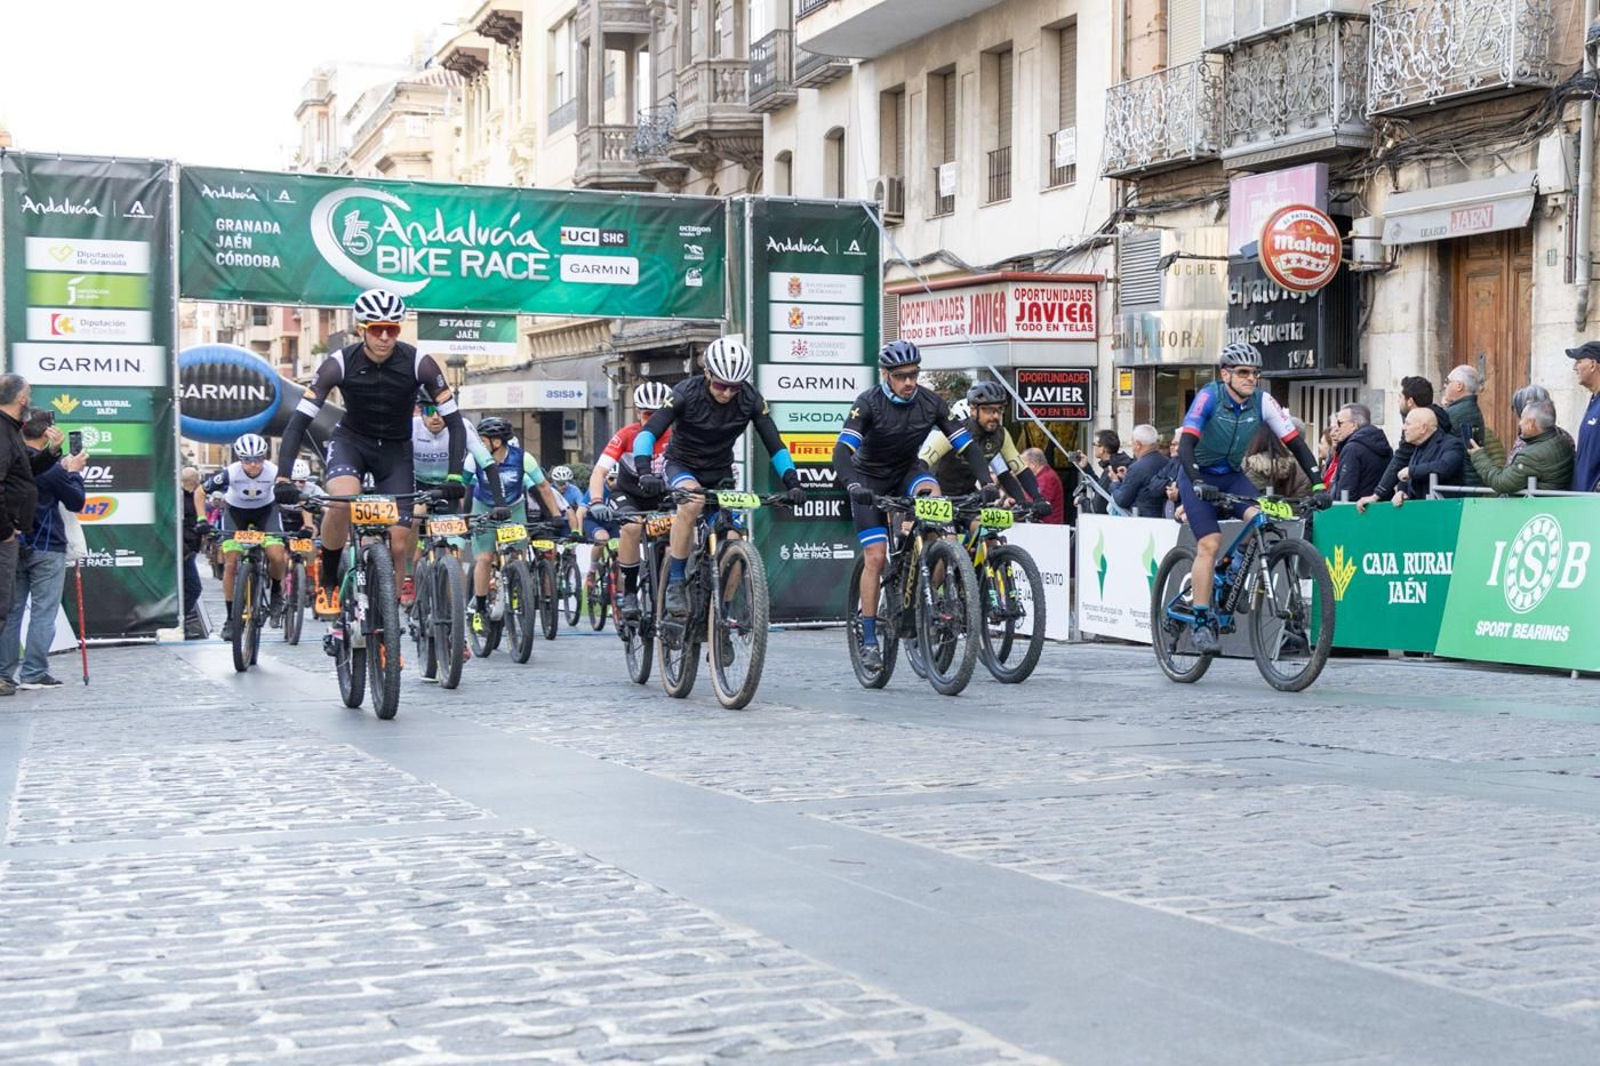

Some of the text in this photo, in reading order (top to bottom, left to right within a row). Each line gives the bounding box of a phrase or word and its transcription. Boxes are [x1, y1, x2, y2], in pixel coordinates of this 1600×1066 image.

[202, 184, 259, 202] Andalucía
[20, 195, 104, 217] Andalucía
[216, 218, 281, 235] GRANADA
[375, 204, 549, 252] Andalucía
[216, 234, 253, 250] JAÉN
[567, 230, 597, 243] UCI
[603, 232, 624, 245] SHC
[766, 236, 829, 255] Andalucía
[1274, 235, 1335, 256] Mahou
[77, 251, 124, 260] Diputación
[216, 251, 281, 269] CÓRDOBA
[377, 246, 551, 282] BIKE RACE
[570, 263, 630, 276] GARMIN
[1014, 288, 1093, 302] OPORTUNIDADES
[901, 291, 1006, 335] OPORTUNIDADES JAVIER
[1015, 302, 1093, 323] JAVIER
[439, 319, 496, 329] STAGE 4
[902, 324, 966, 340] TODO EN TELAS
[1015, 323, 1093, 332] TODO EN TELAS
[456, 330, 480, 339] JAÉN
[39, 357, 141, 373] GARMIN
[1288, 349, 1315, 369] 1974
[778, 376, 855, 390] GARMIN
[1019, 372, 1089, 384] OPORTUNIDADES
[546, 390, 576, 399] asisa
[1024, 386, 1082, 402] JAVIER
[82, 400, 132, 408] CAJA RURAL
[1048, 407, 1060, 417] EN
[790, 442, 836, 454] PIREL
[355, 503, 395, 521] 504-2
[918, 501, 950, 518] 332-2
[982, 511, 1010, 526] 349-1
[793, 551, 811, 560] BIKE
[812, 551, 832, 560] RACE
[1362, 552, 1399, 576] CAJA
[1388, 577, 1427, 604] JAÉN
[1475, 619, 1570, 643] SPORT BEARINGS
